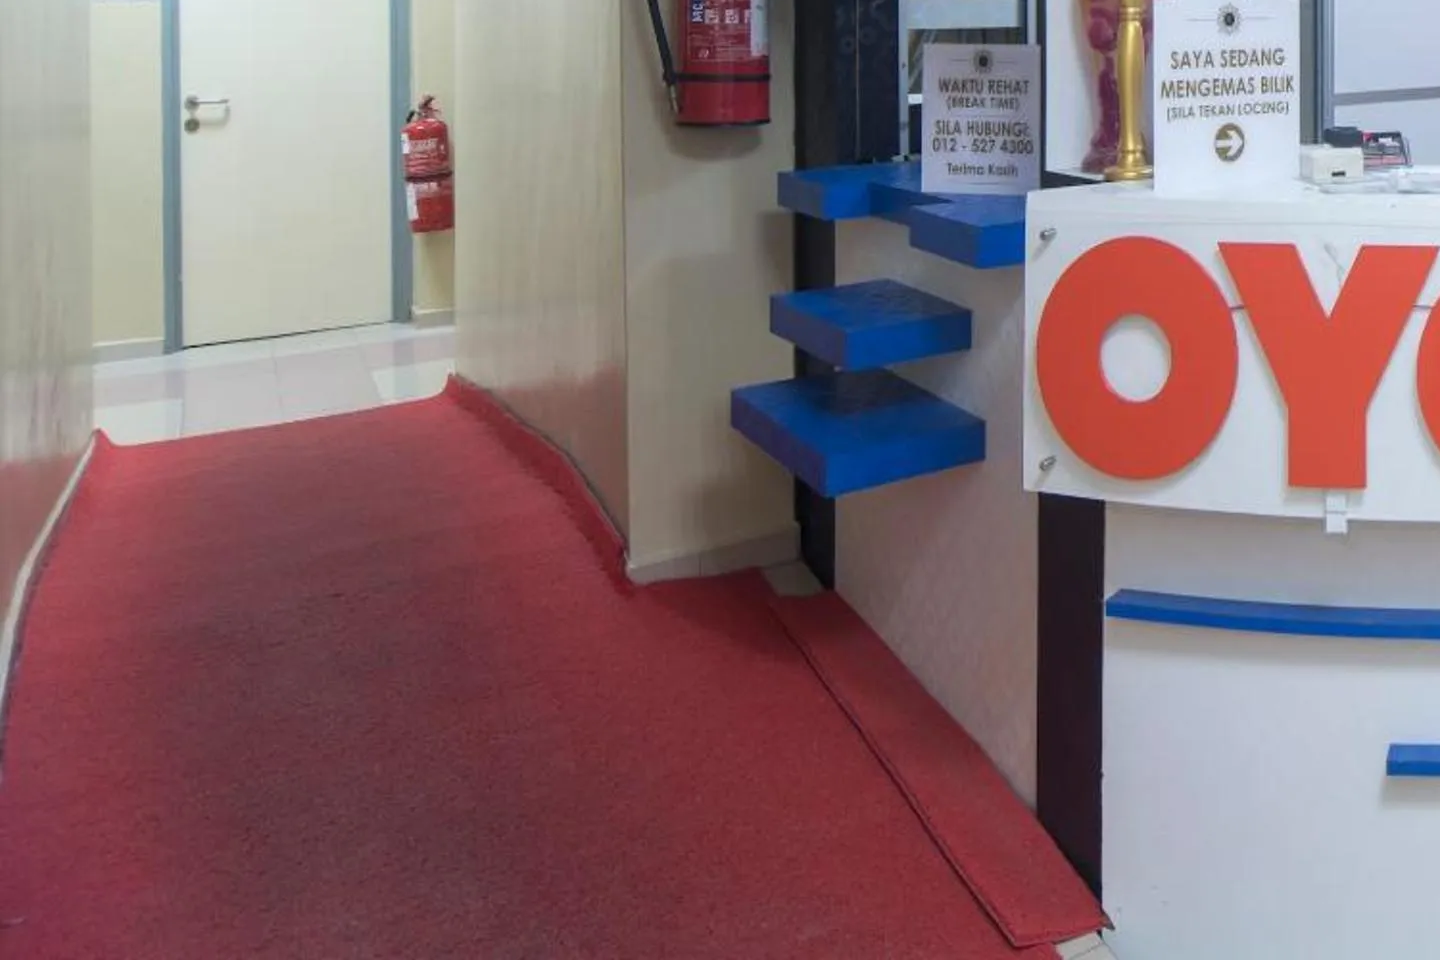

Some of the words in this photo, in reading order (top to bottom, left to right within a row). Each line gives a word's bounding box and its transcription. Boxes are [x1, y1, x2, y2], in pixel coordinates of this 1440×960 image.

[1170, 50, 1215, 69] SAYA
[1220, 47, 1286, 68] SEDANG
[938, 77, 984, 93] WAKTU
[987, 79, 1030, 95] REHAT
[1161, 76, 1256, 98] MENGEMAS
[1260, 74, 1295, 94] BILIK
[1166, 105, 1195, 121] (SILA
[1198, 103, 1235, 118] TEKAN
[935, 120, 962, 136] SILA
[932, 137, 957, 153] 012
[1000, 139, 1034, 155] 4300
[947, 162, 985, 176] Terima
[988, 163, 1019, 178] Kasih
